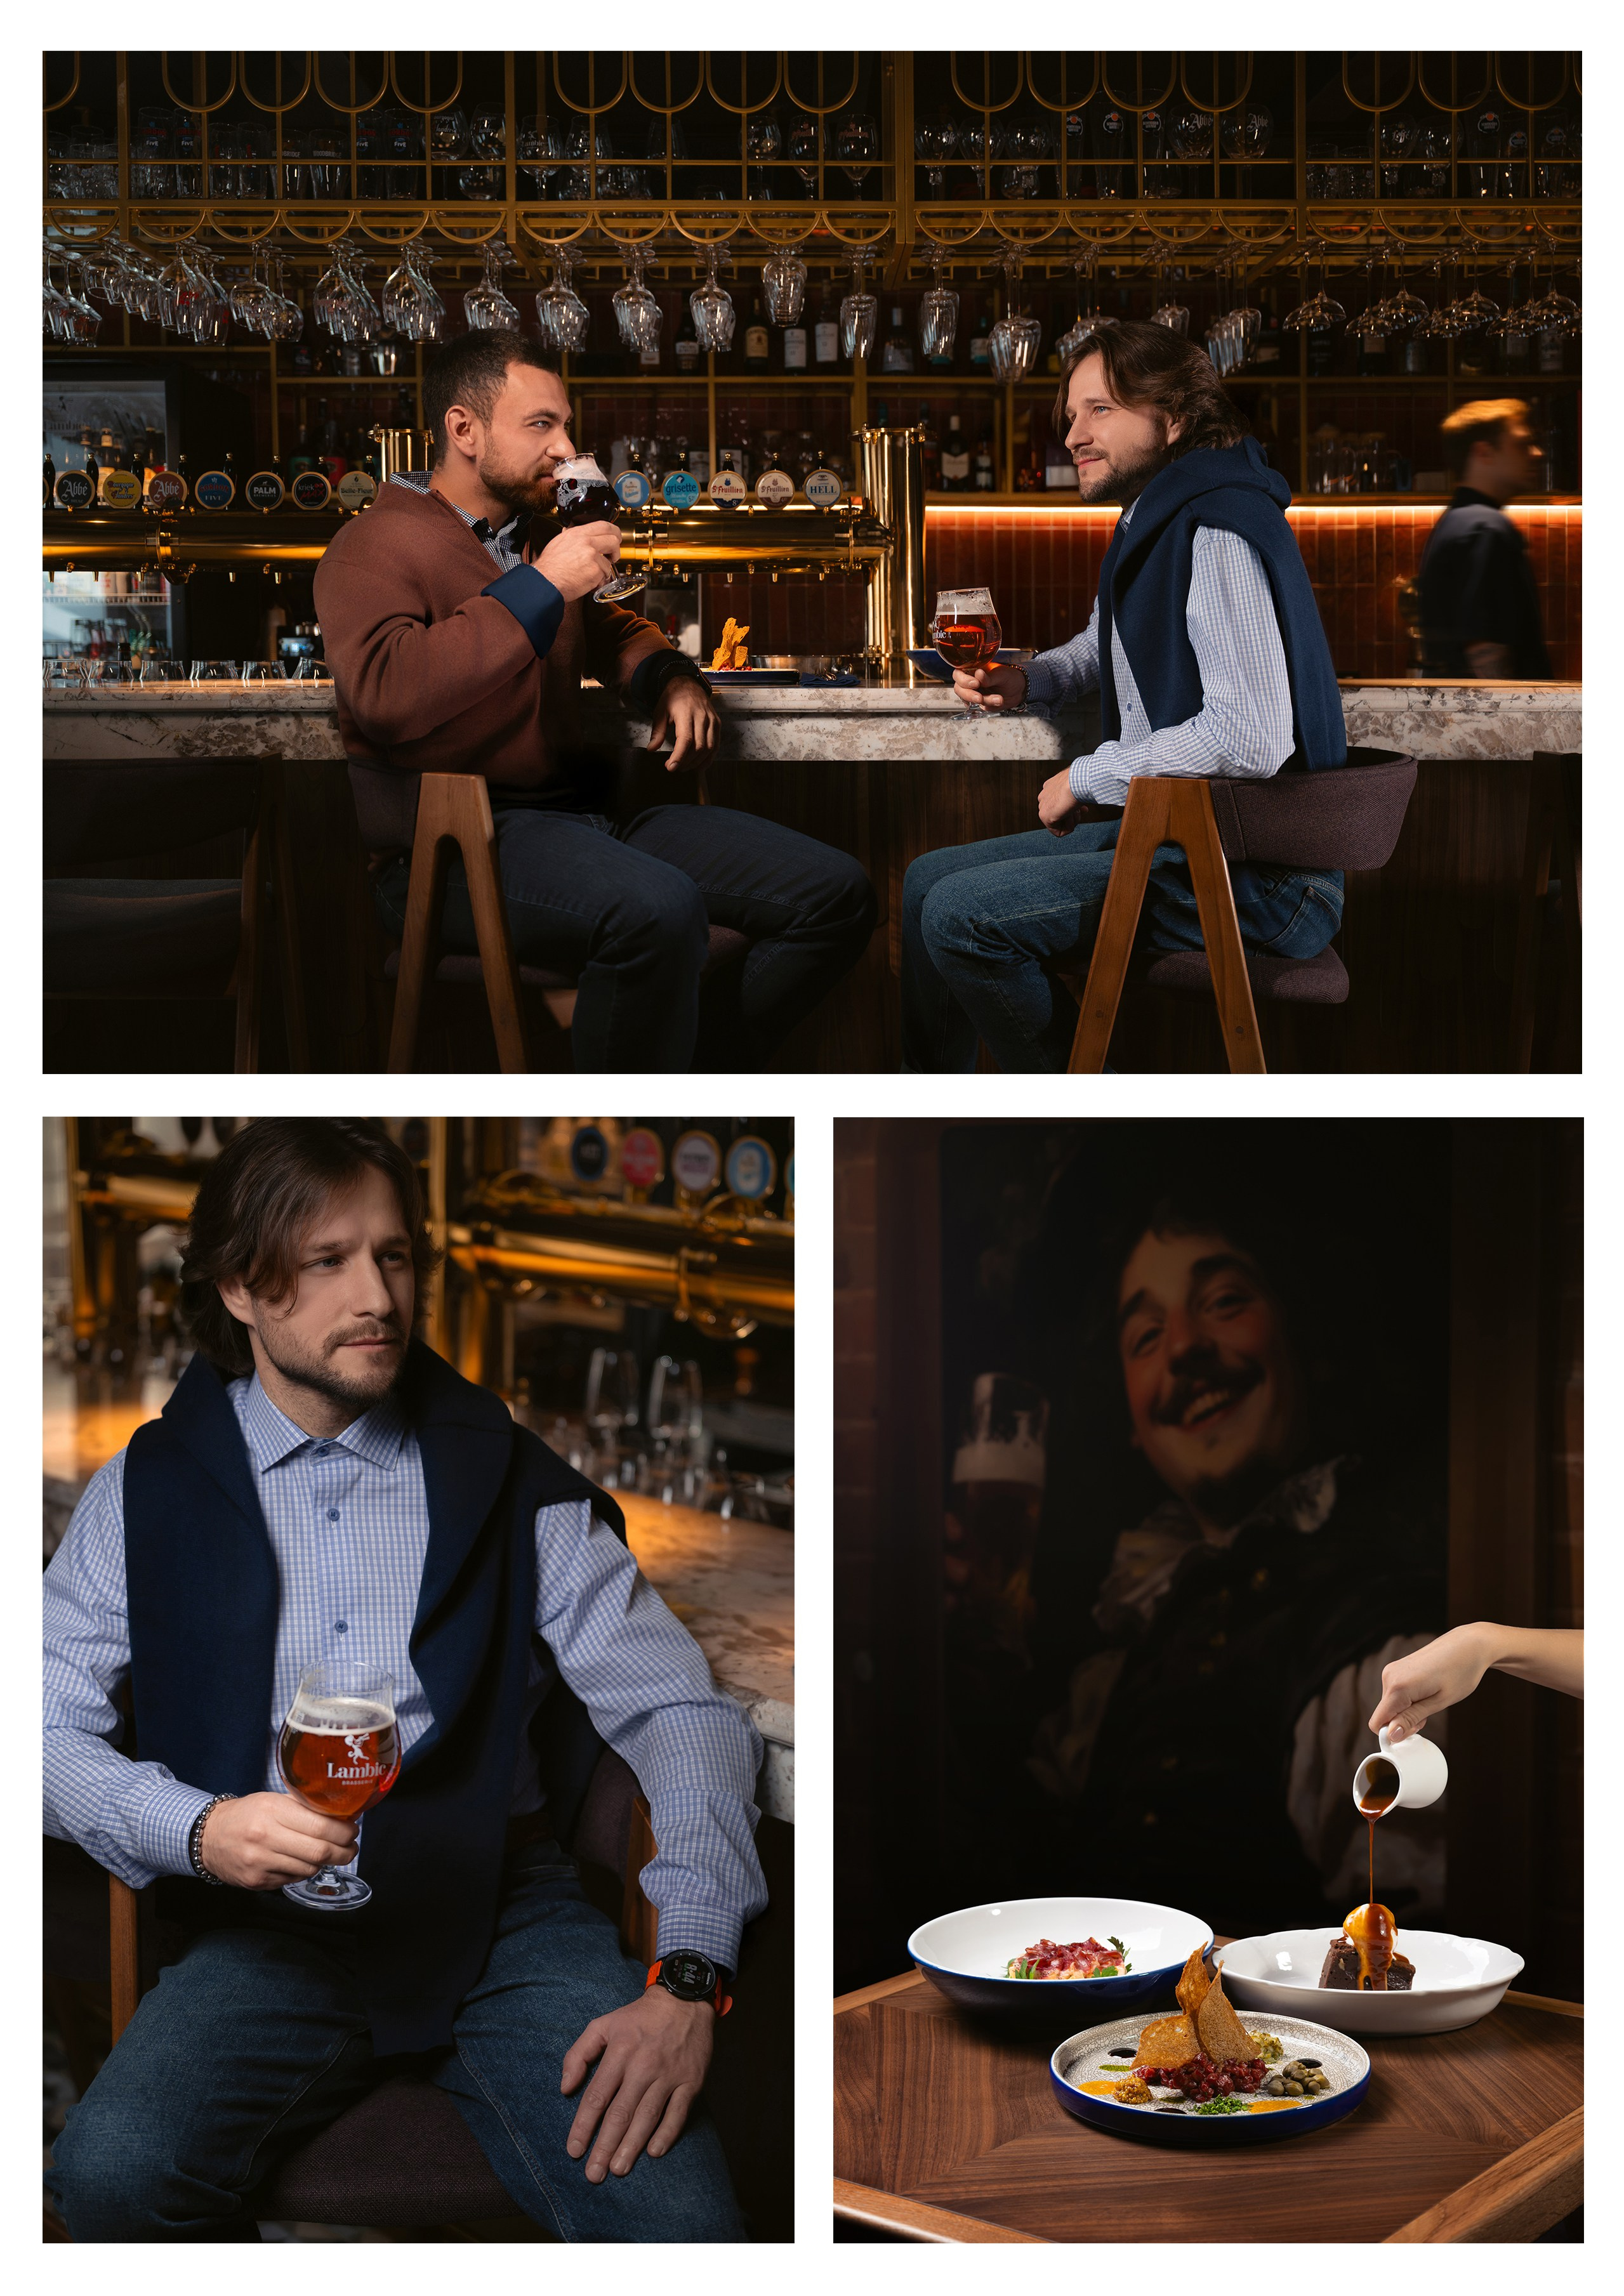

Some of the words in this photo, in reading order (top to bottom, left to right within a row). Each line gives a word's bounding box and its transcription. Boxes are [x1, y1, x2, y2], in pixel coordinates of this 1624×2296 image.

[61, 480, 88, 502] Abbé
[153, 480, 180, 502] Abbé
[298, 484, 315, 492] kriek
[665, 484, 697, 496] grisette
[810, 485, 836, 494] HELL
[326, 1762, 386, 1779] Lambic
[682, 1962, 697, 1984] 8:44
